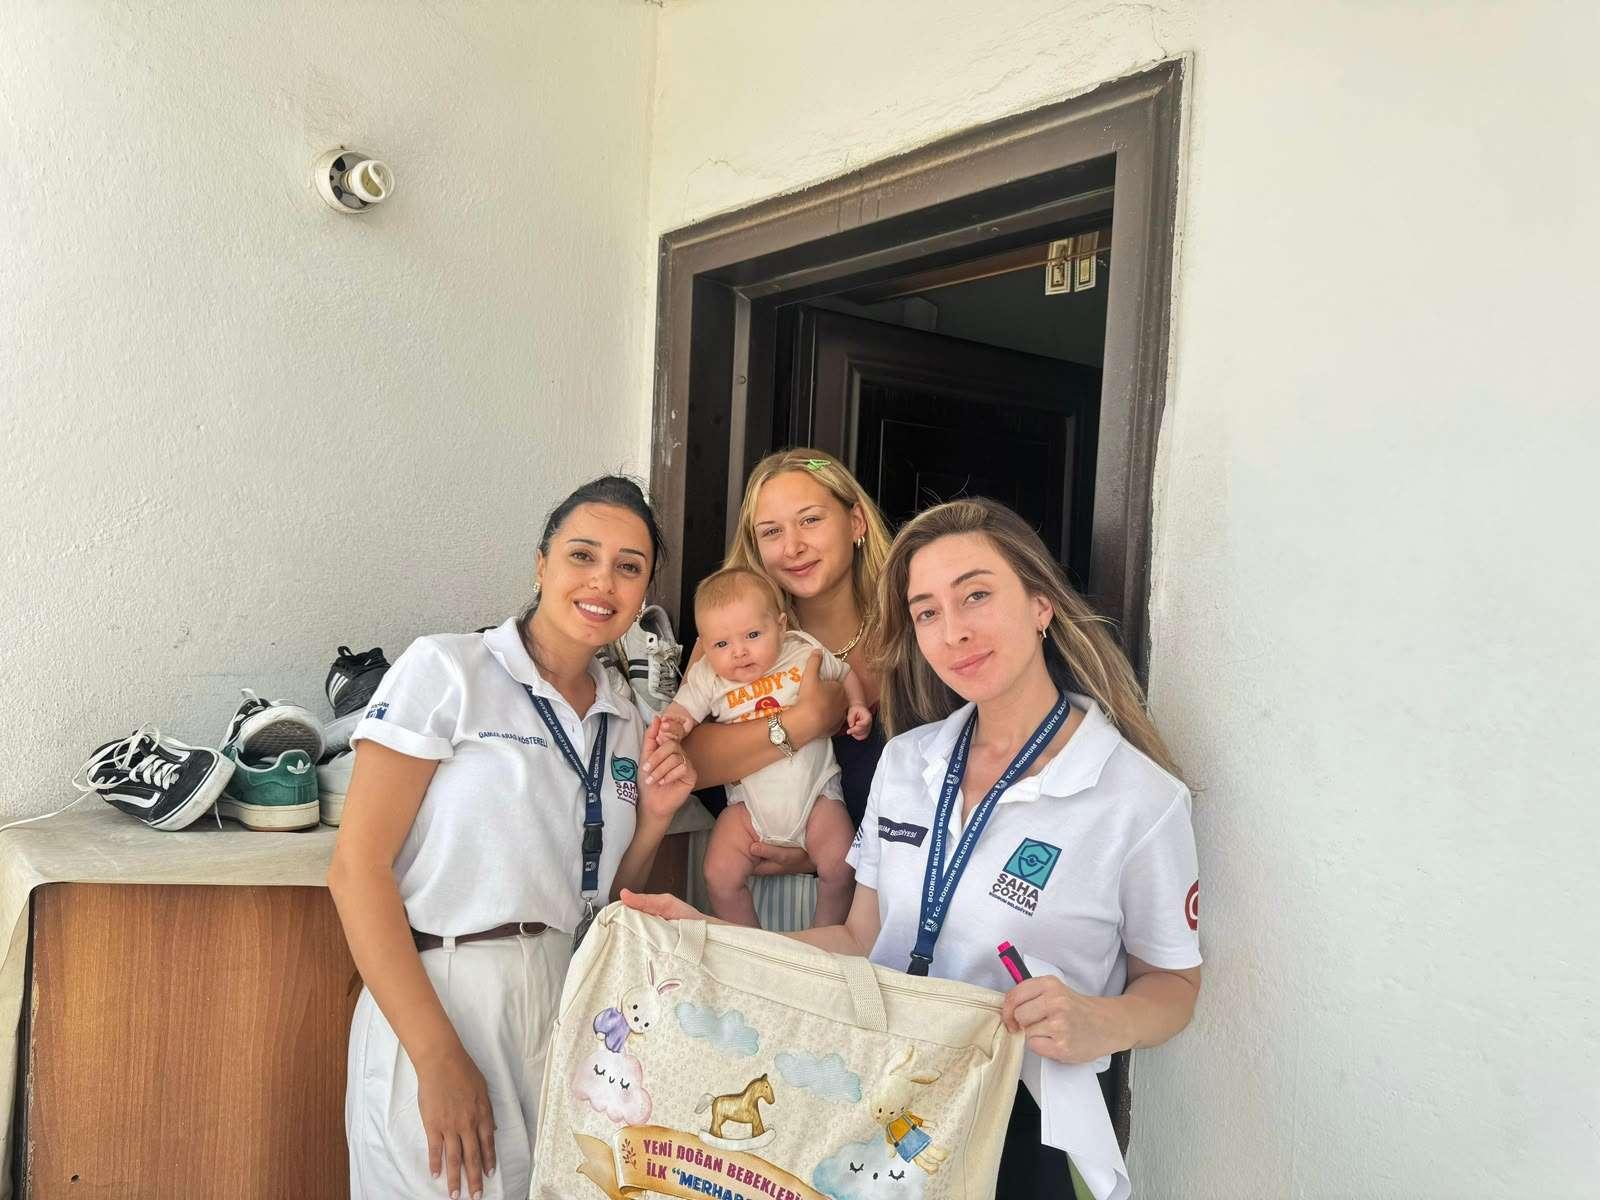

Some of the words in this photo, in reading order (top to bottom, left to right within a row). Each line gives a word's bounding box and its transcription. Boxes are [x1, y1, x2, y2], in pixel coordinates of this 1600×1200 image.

[726, 666, 801, 709] DADDY'S
[1005, 768, 1017, 780] T.C.
[1015, 744, 1037, 769] BODRUM
[1036, 715, 1060, 744] BELEDİYE
[615, 781, 638, 793] SAH
[938, 785, 954, 828] BAŞKANLIĞI
[932, 903, 943, 918] T.C.
[939, 871, 956, 903] BODRUM
[954, 833, 974, 872] BELEDİYE
[972, 788, 998, 832] BAŞKANLIĞI
[934, 829, 943, 868] BELEDİYE
[927, 868, 938, 903] BODRUM
[992, 883, 1037, 911] ÇÖZÜM
[997, 873, 1039, 902] SAHA
[643, 1139, 673, 1158] YENİ
[676, 1145, 724, 1173] DOĞAN
[646, 1158, 668, 1180] İLK
